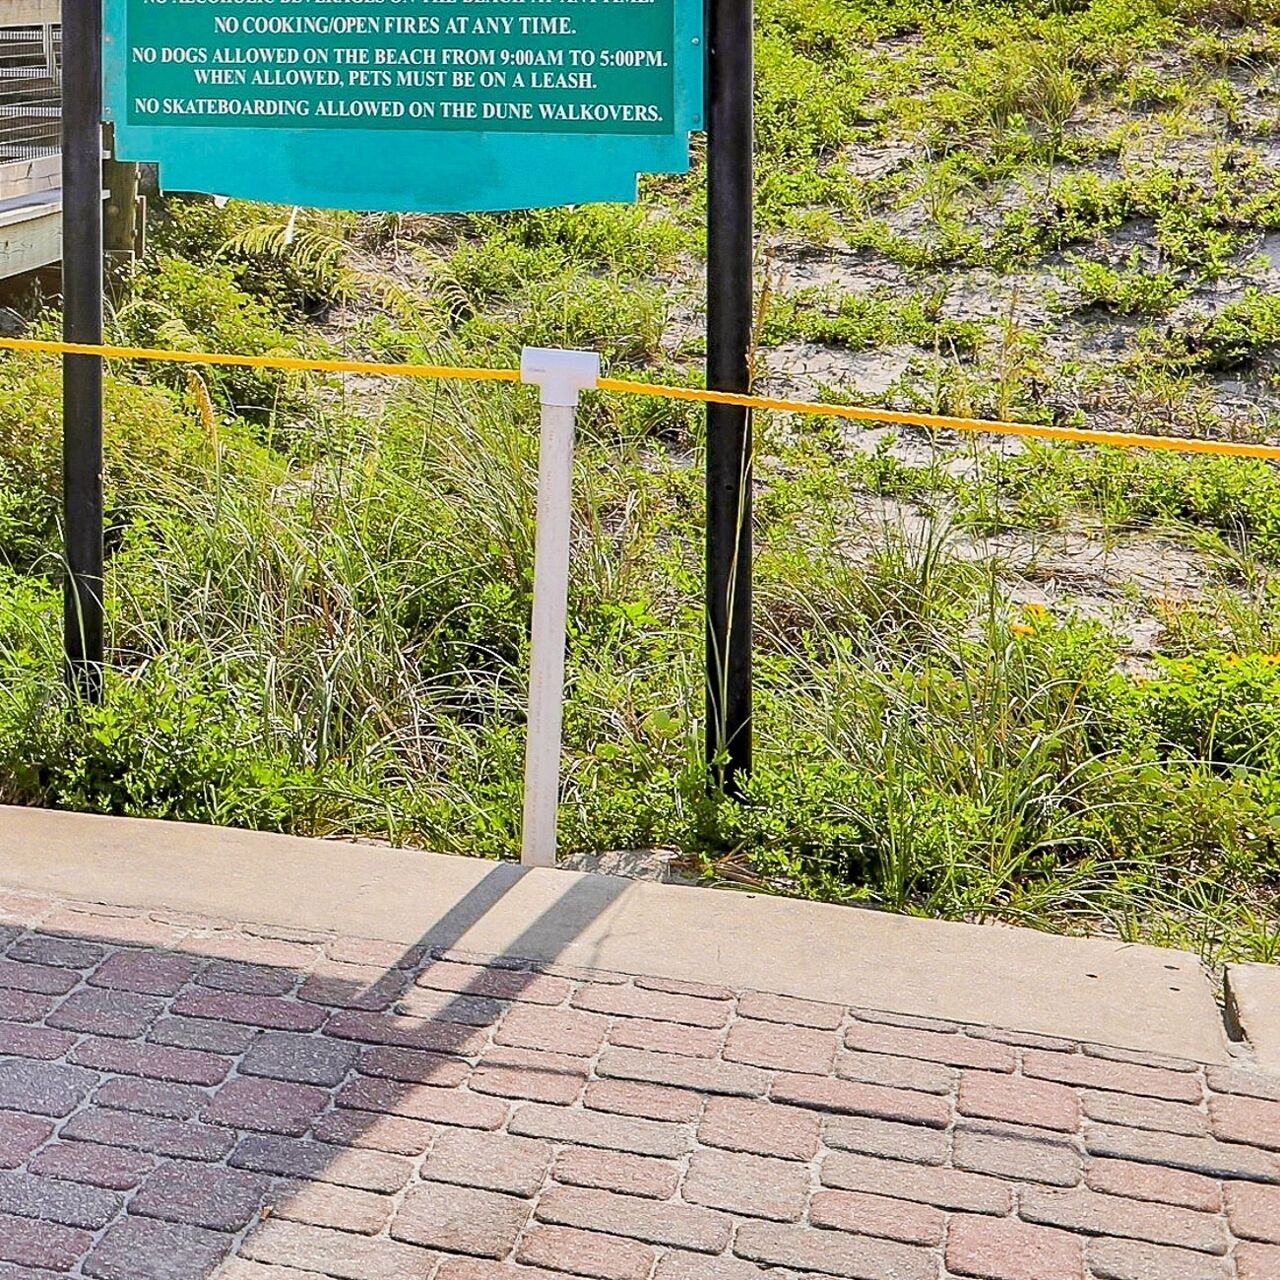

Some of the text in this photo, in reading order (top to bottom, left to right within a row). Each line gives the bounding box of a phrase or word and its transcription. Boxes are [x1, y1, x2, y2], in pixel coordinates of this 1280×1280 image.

[214, 17, 576, 34] NO COOKING/OPEN FIRES AT ANY TIME.
[132, 48, 667, 66] NO DOGS ALLOWED ON THE BEACH FROM 9:00AM TO 5:00PM.
[194, 70, 597, 88] WHEN ALLOWED, PETS MUST BE ON A LEASH.
[135, 98, 663, 121] NO SKATEBOARDING ALLOWED ON THE DUNE WALKOVERS.
